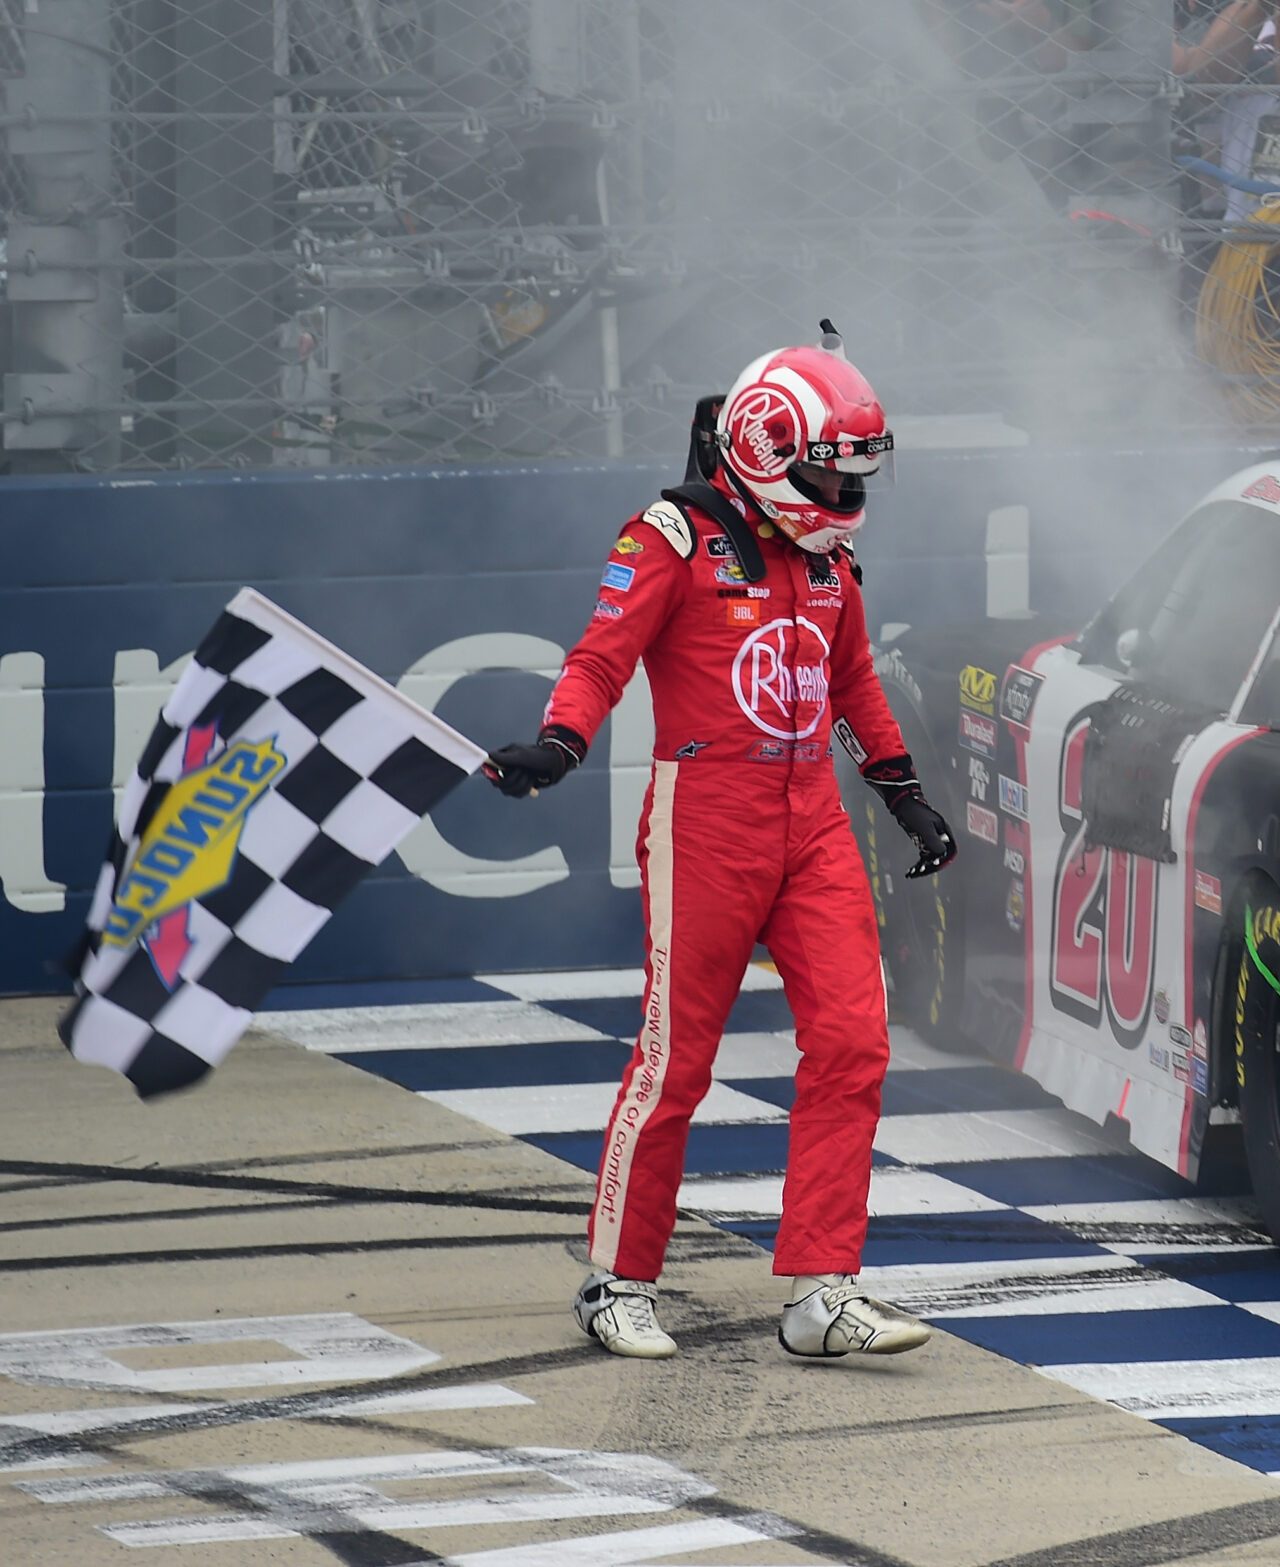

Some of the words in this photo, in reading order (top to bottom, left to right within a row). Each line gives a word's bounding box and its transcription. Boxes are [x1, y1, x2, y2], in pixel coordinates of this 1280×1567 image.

[733, 392, 787, 471] Rheem
[718, 586, 771, 599] GameStop
[734, 605, 755, 620] JBL
[1050, 713, 1160, 1051] 20
[654, 946, 668, 986] The
[647, 992, 663, 1037] new
[635, 1040, 665, 1103] degree
[621, 1106, 640, 1130] of
